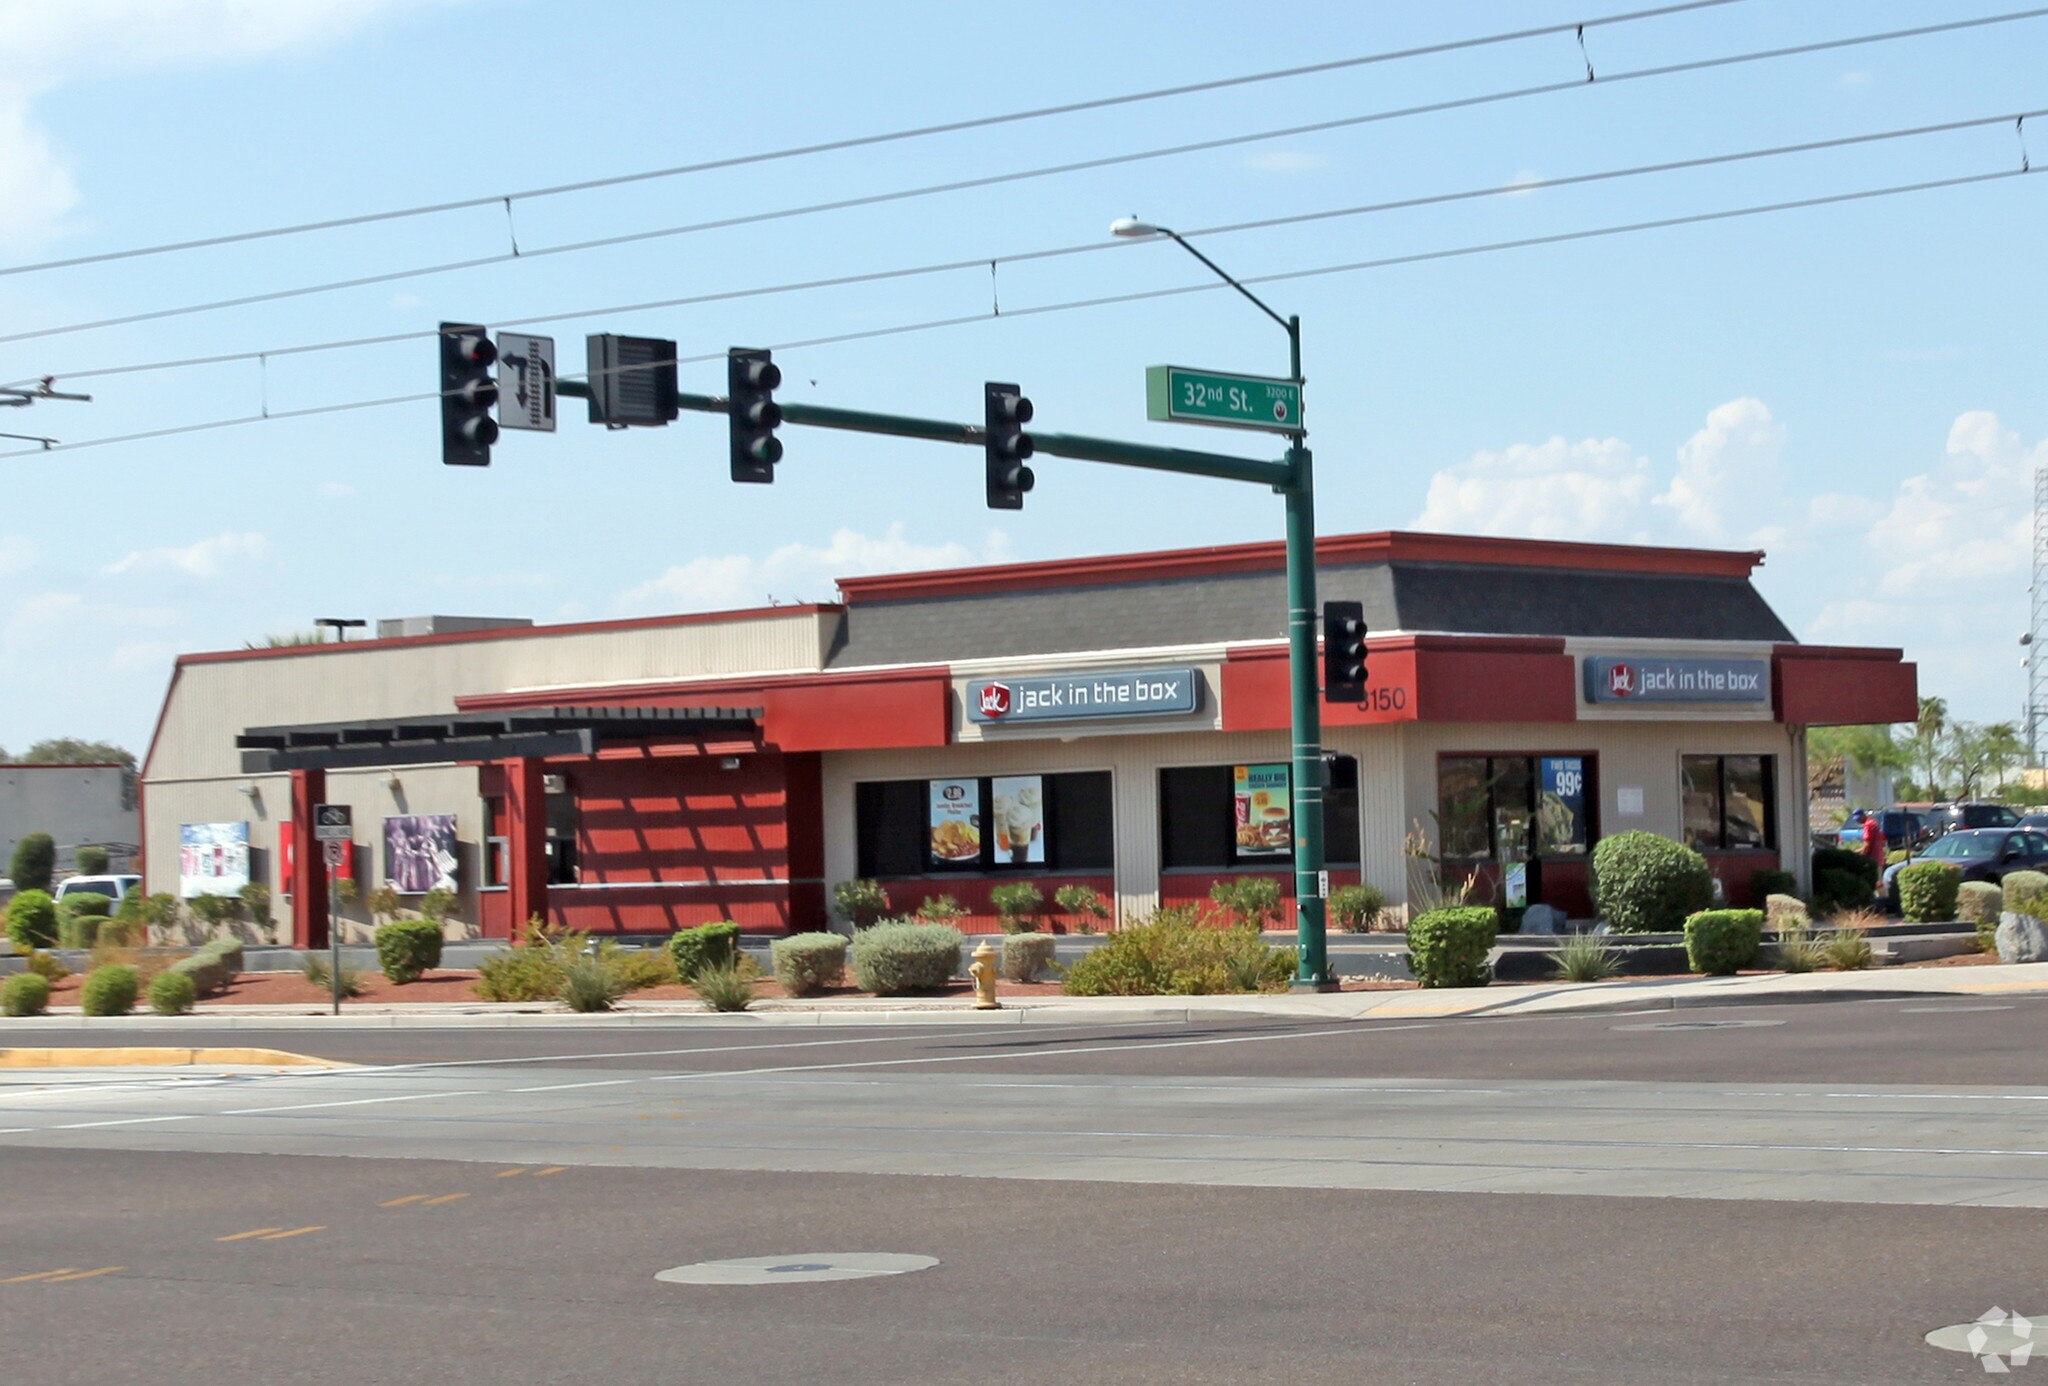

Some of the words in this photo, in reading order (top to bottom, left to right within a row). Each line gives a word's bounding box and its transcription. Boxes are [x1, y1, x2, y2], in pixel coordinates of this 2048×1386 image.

[1184, 382, 1223, 407] 32nd
[1229, 387, 1253, 412] St.
[1266, 386, 1287, 398] 3200
[1289, 390, 1294, 400] E
[1638, 668, 1675, 696] jack
[1679, 668, 1694, 690] in
[1698, 669, 1725, 690] the
[1728, 670, 1759, 691] box
[1017, 684, 1063, 714] jack
[1069, 684, 1088, 705] in
[1094, 682, 1130, 703] the
[1136, 679, 1178, 701] box
[1556, 771, 1583, 796] 99¢
